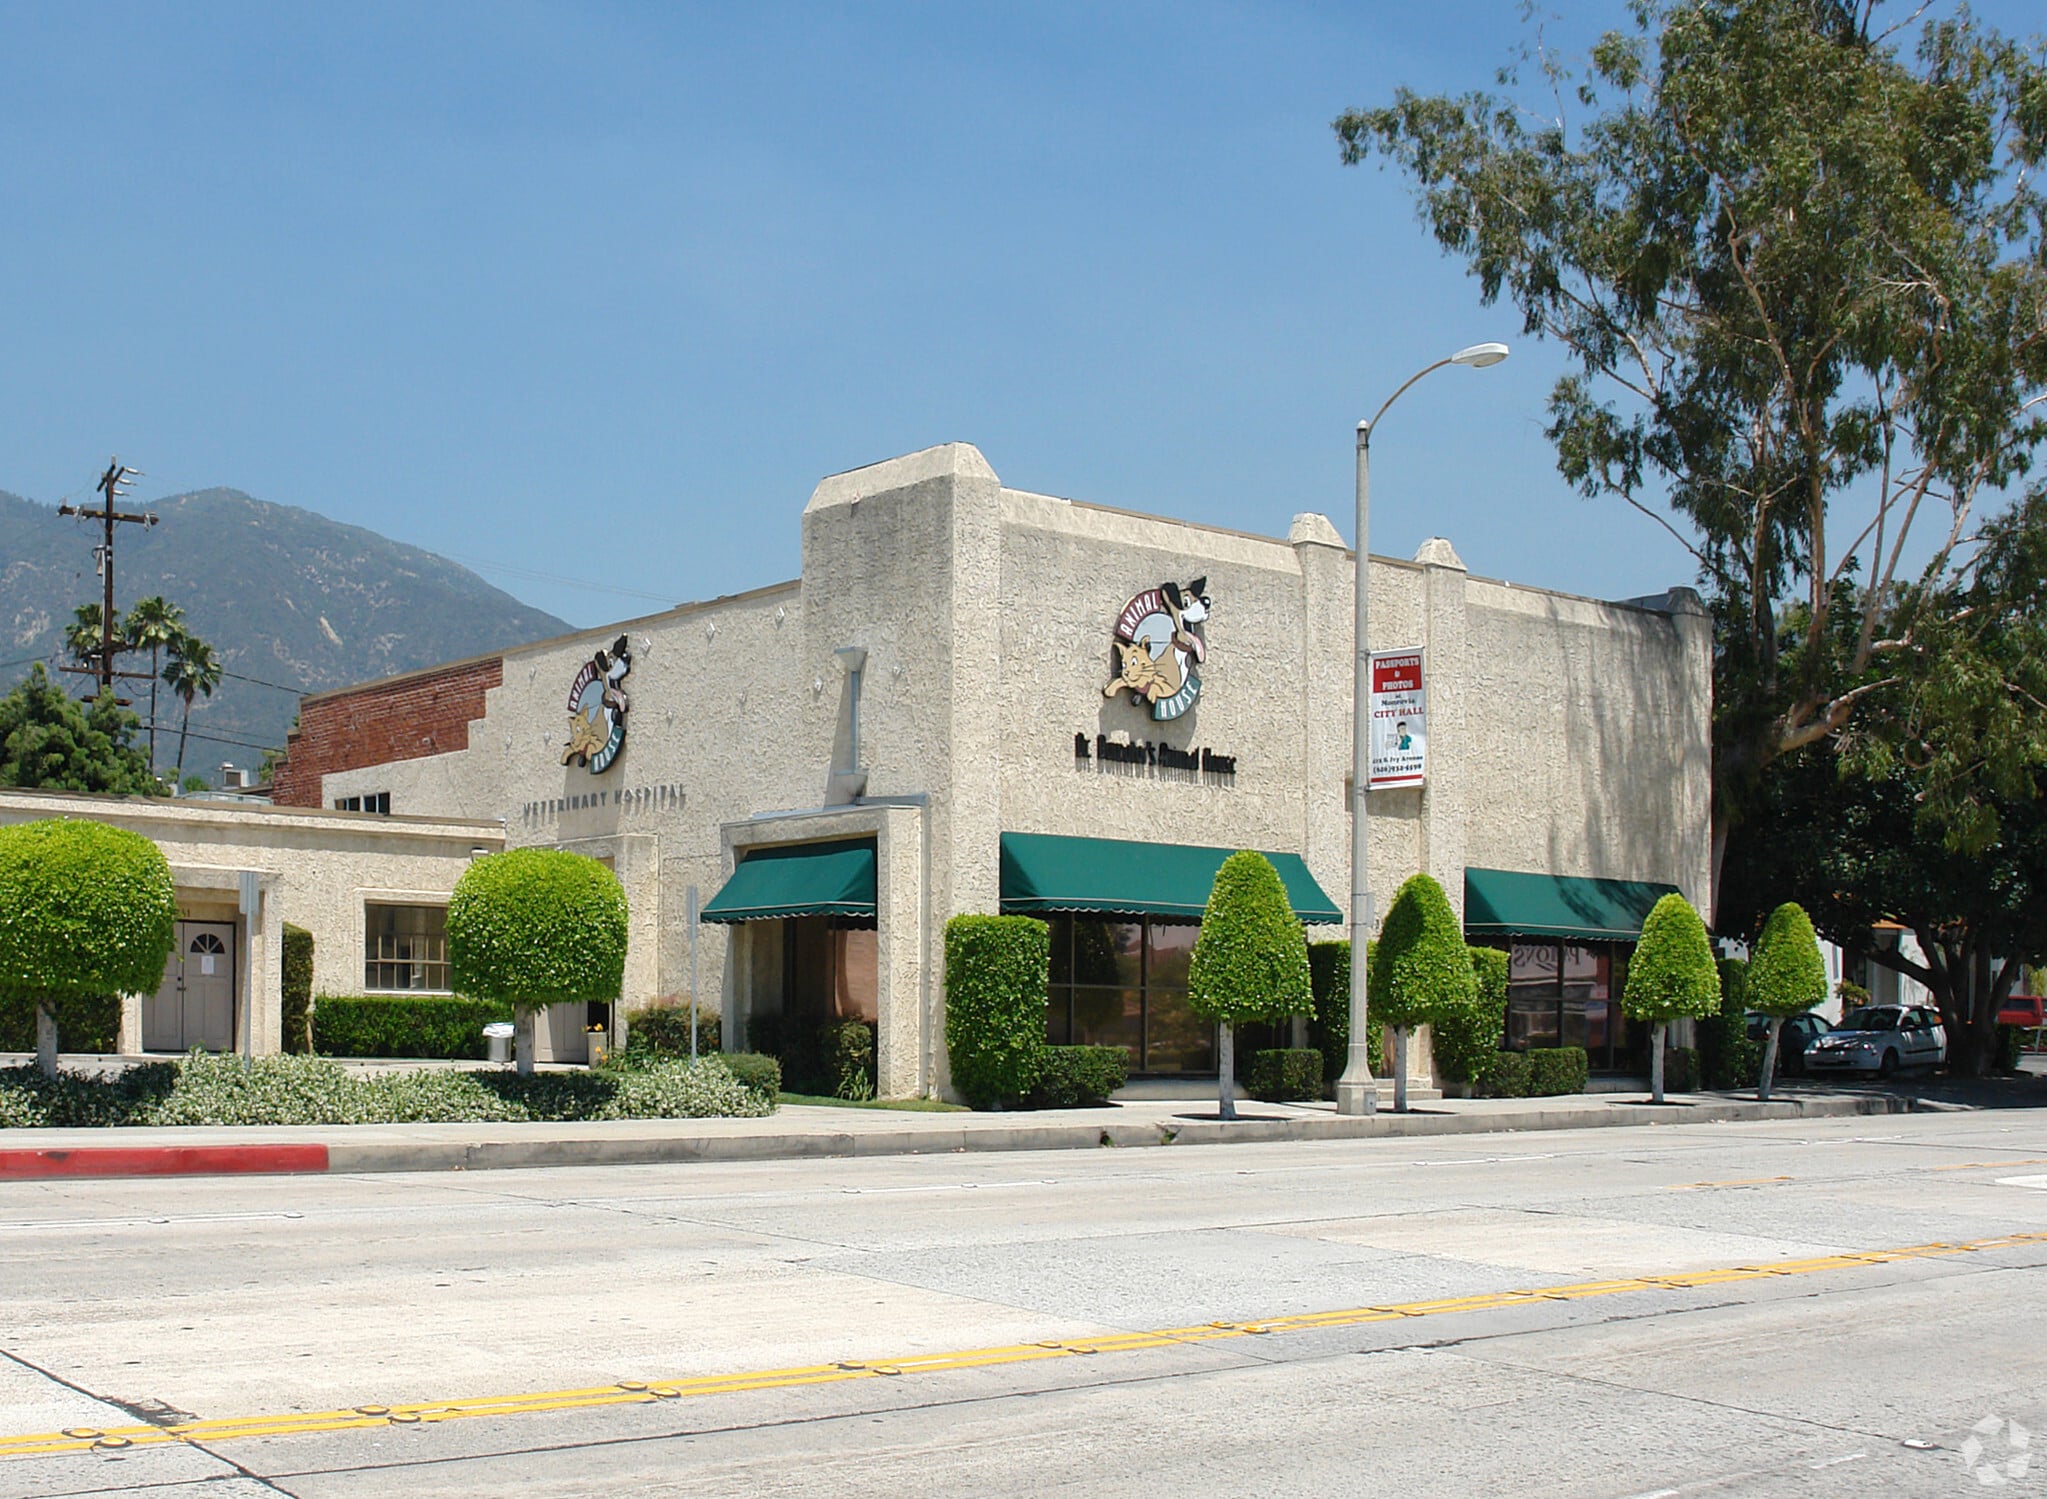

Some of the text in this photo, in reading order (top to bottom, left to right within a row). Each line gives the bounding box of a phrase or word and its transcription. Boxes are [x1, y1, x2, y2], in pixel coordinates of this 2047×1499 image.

[1120, 592, 1159, 637] ANIMAL
[1375, 657, 1419, 669] PASSPORTS
[569, 664, 594, 710] ANIMAL
[1160, 680, 1198, 718] HOUSE
[1381, 698, 1415, 706] Monrovia
[1382, 680, 1414, 691] PHOTOS
[1374, 707, 1424, 718] CITY HALL
[594, 732, 620, 773] HOUSE
[523, 783, 687, 816] VETERINARY HOSPITAL
